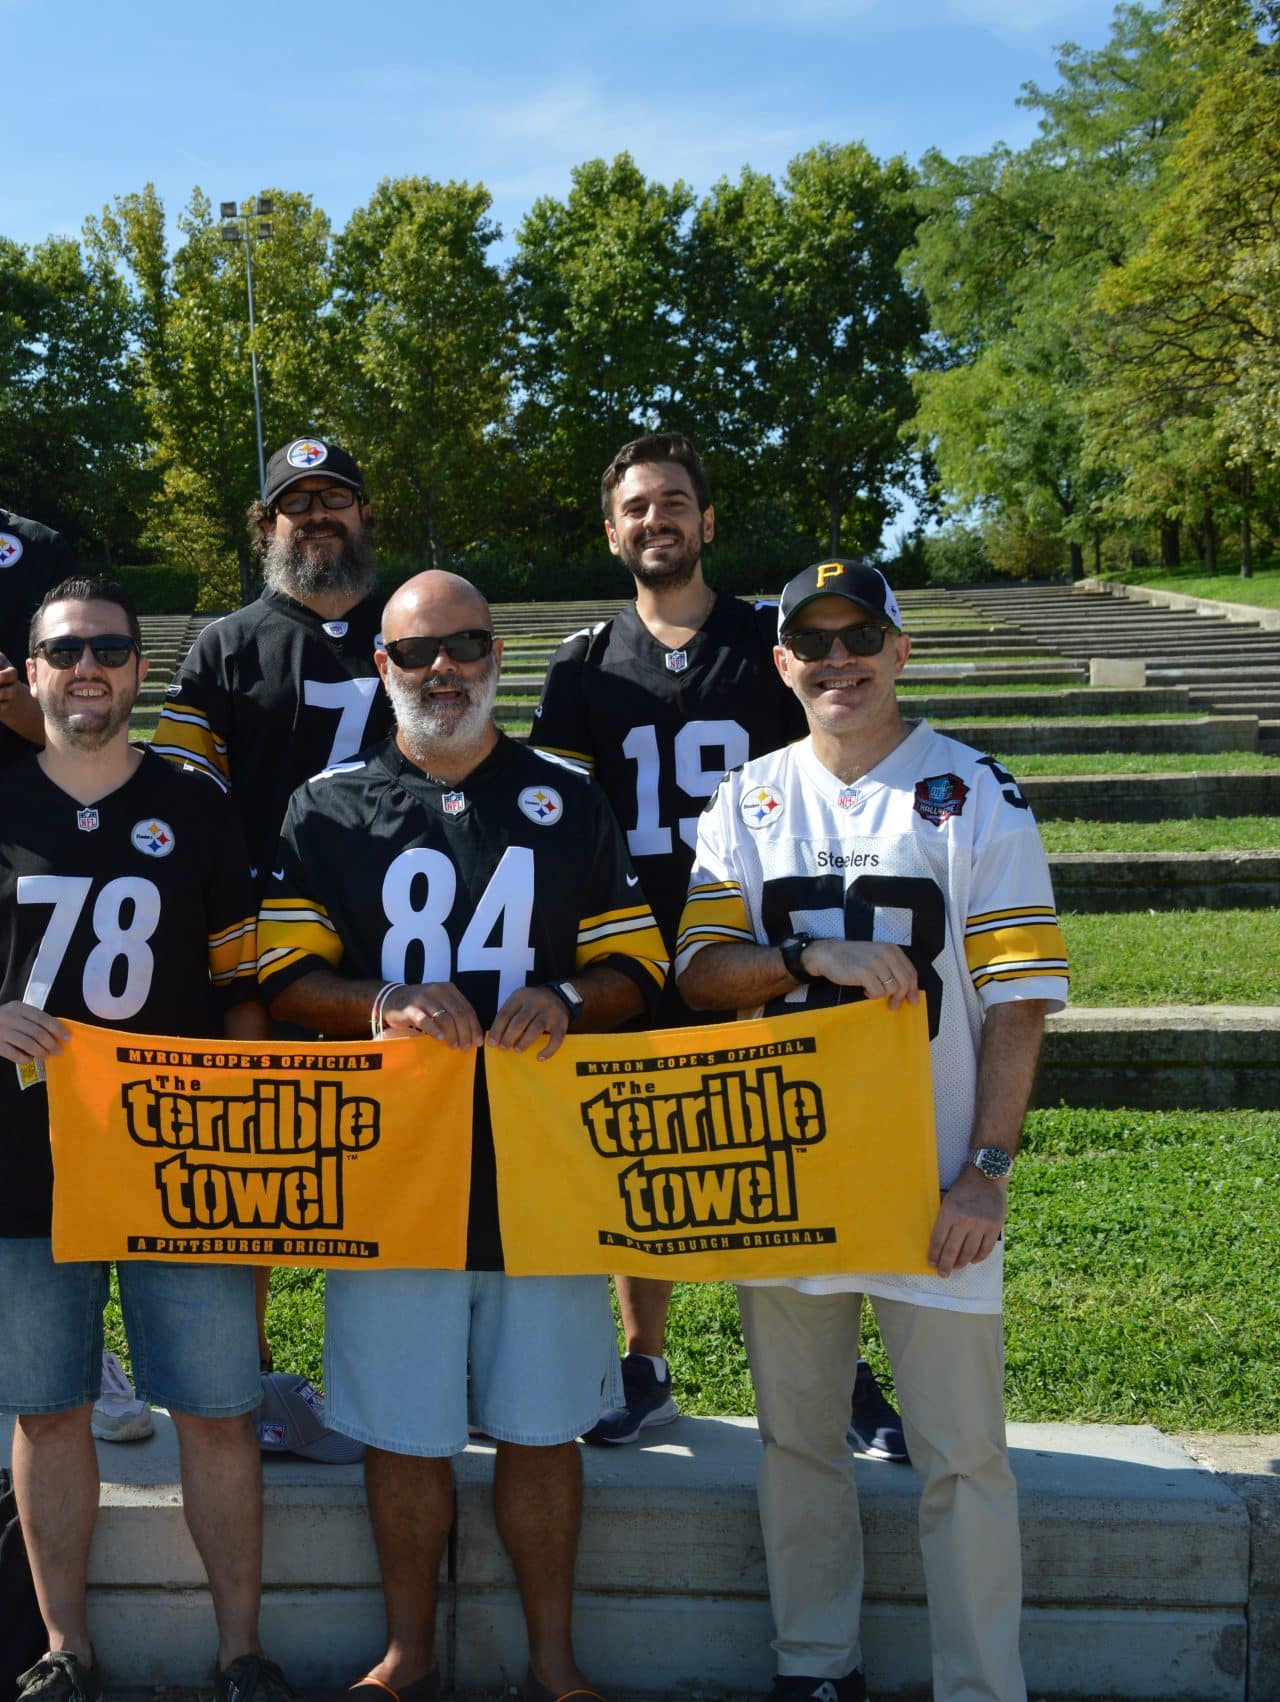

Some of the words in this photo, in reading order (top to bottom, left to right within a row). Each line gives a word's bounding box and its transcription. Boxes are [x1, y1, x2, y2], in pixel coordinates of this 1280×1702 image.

[816, 562, 846, 588] P
[303, 677, 380, 767] 7
[622, 720, 750, 857] 19
[817, 850, 879, 868] Steelers
[17, 874, 161, 1021] 78
[381, 846, 536, 1012] 84
[128, 1050, 194, 1066] MYRON
[203, 1053, 271, 1068] COPE'S
[281, 1055, 370, 1069] OFFICIAL
[156, 1074, 201, 1092] The
[588, 1060, 644, 1074] MYRON
[657, 1054, 715, 1070] COPE'S
[728, 1041, 805, 1062] OFFICIAL
[580, 1065, 827, 1159] terrible
[613, 1081, 655, 1096] The
[121, 1078, 381, 1155] terrible
[154, 1151, 344, 1230] towel
[618, 1144, 799, 1233] towel
[137, 1238, 147, 1250] A
[156, 1239, 274, 1254] PITTSBURGH
[283, 1240, 370, 1256] ORIGINAL
[606, 1233, 615, 1245] A
[626, 1235, 729, 1254] PITTSBURGH
[743, 1230, 825, 1249] ORIGINAL
